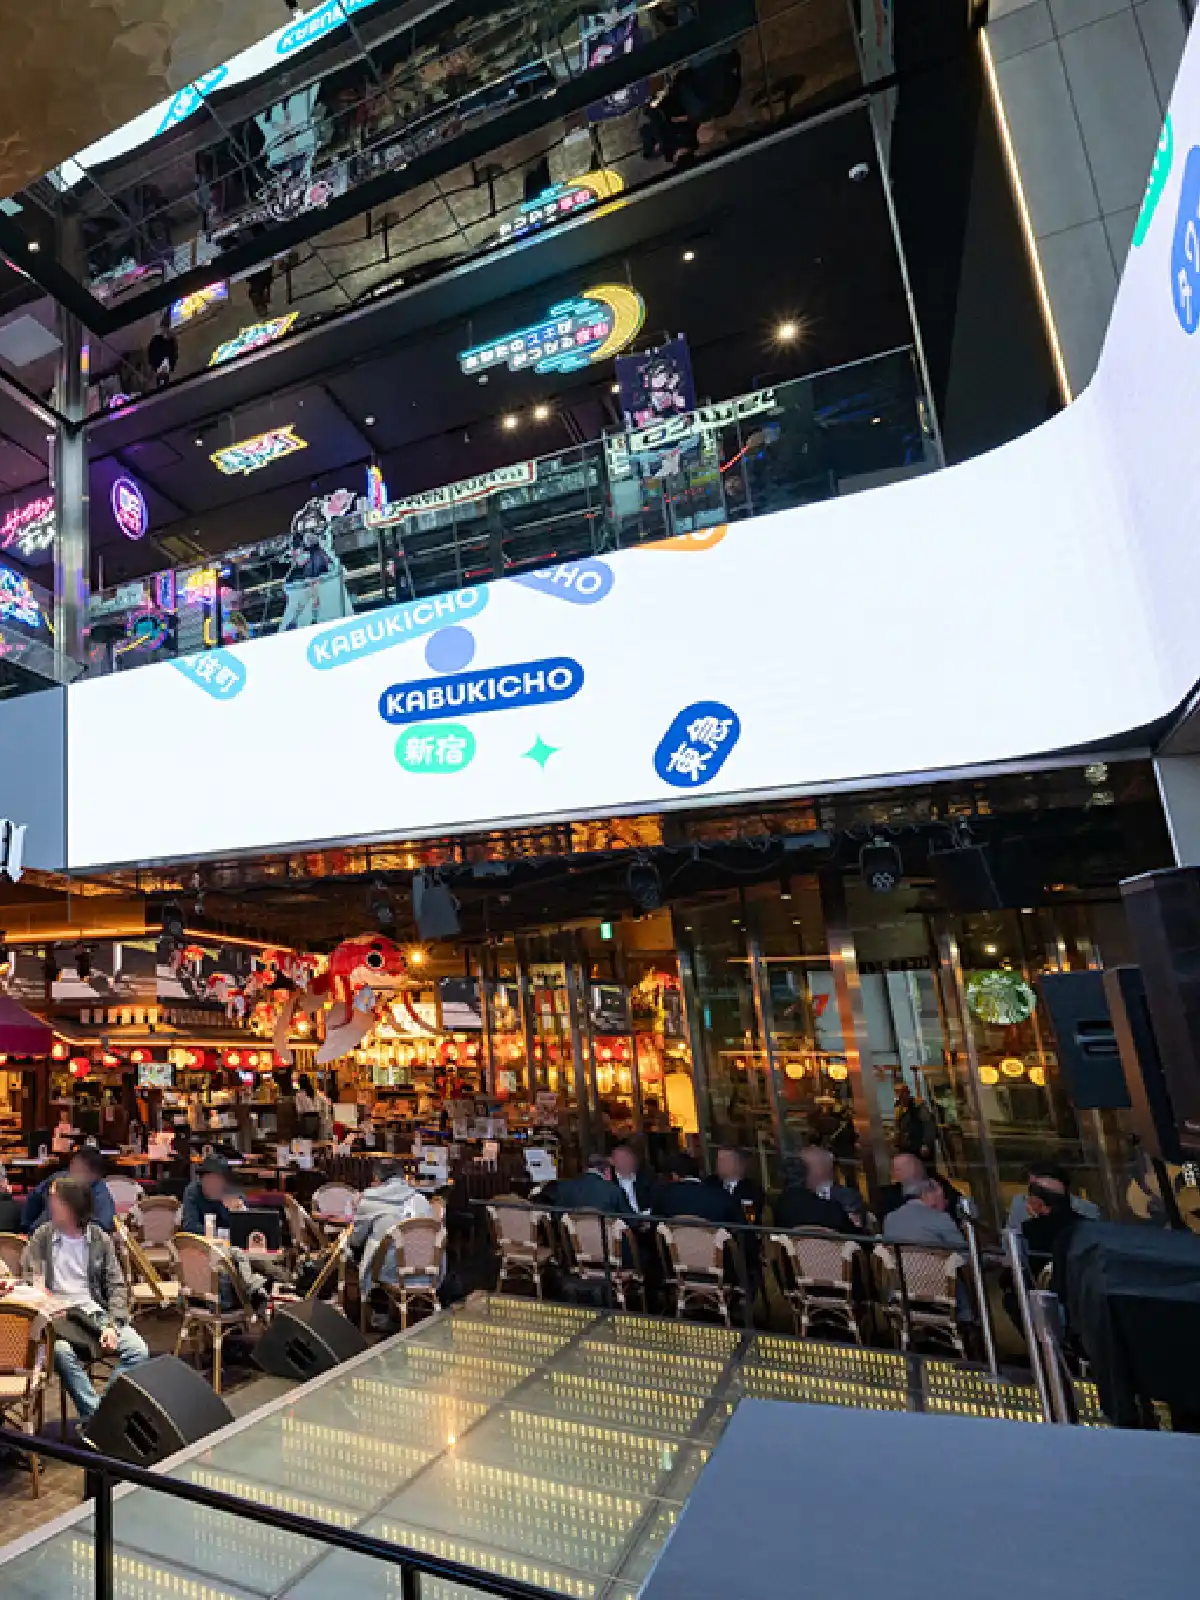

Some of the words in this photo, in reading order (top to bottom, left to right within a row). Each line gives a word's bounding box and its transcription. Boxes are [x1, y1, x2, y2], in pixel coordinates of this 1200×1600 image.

[313, 588, 479, 665] KABUKICHO
[386, 667, 573, 716] KABUKICHO
[404, 734, 468, 766] 新宿
[666, 716, 733, 782] 東急
